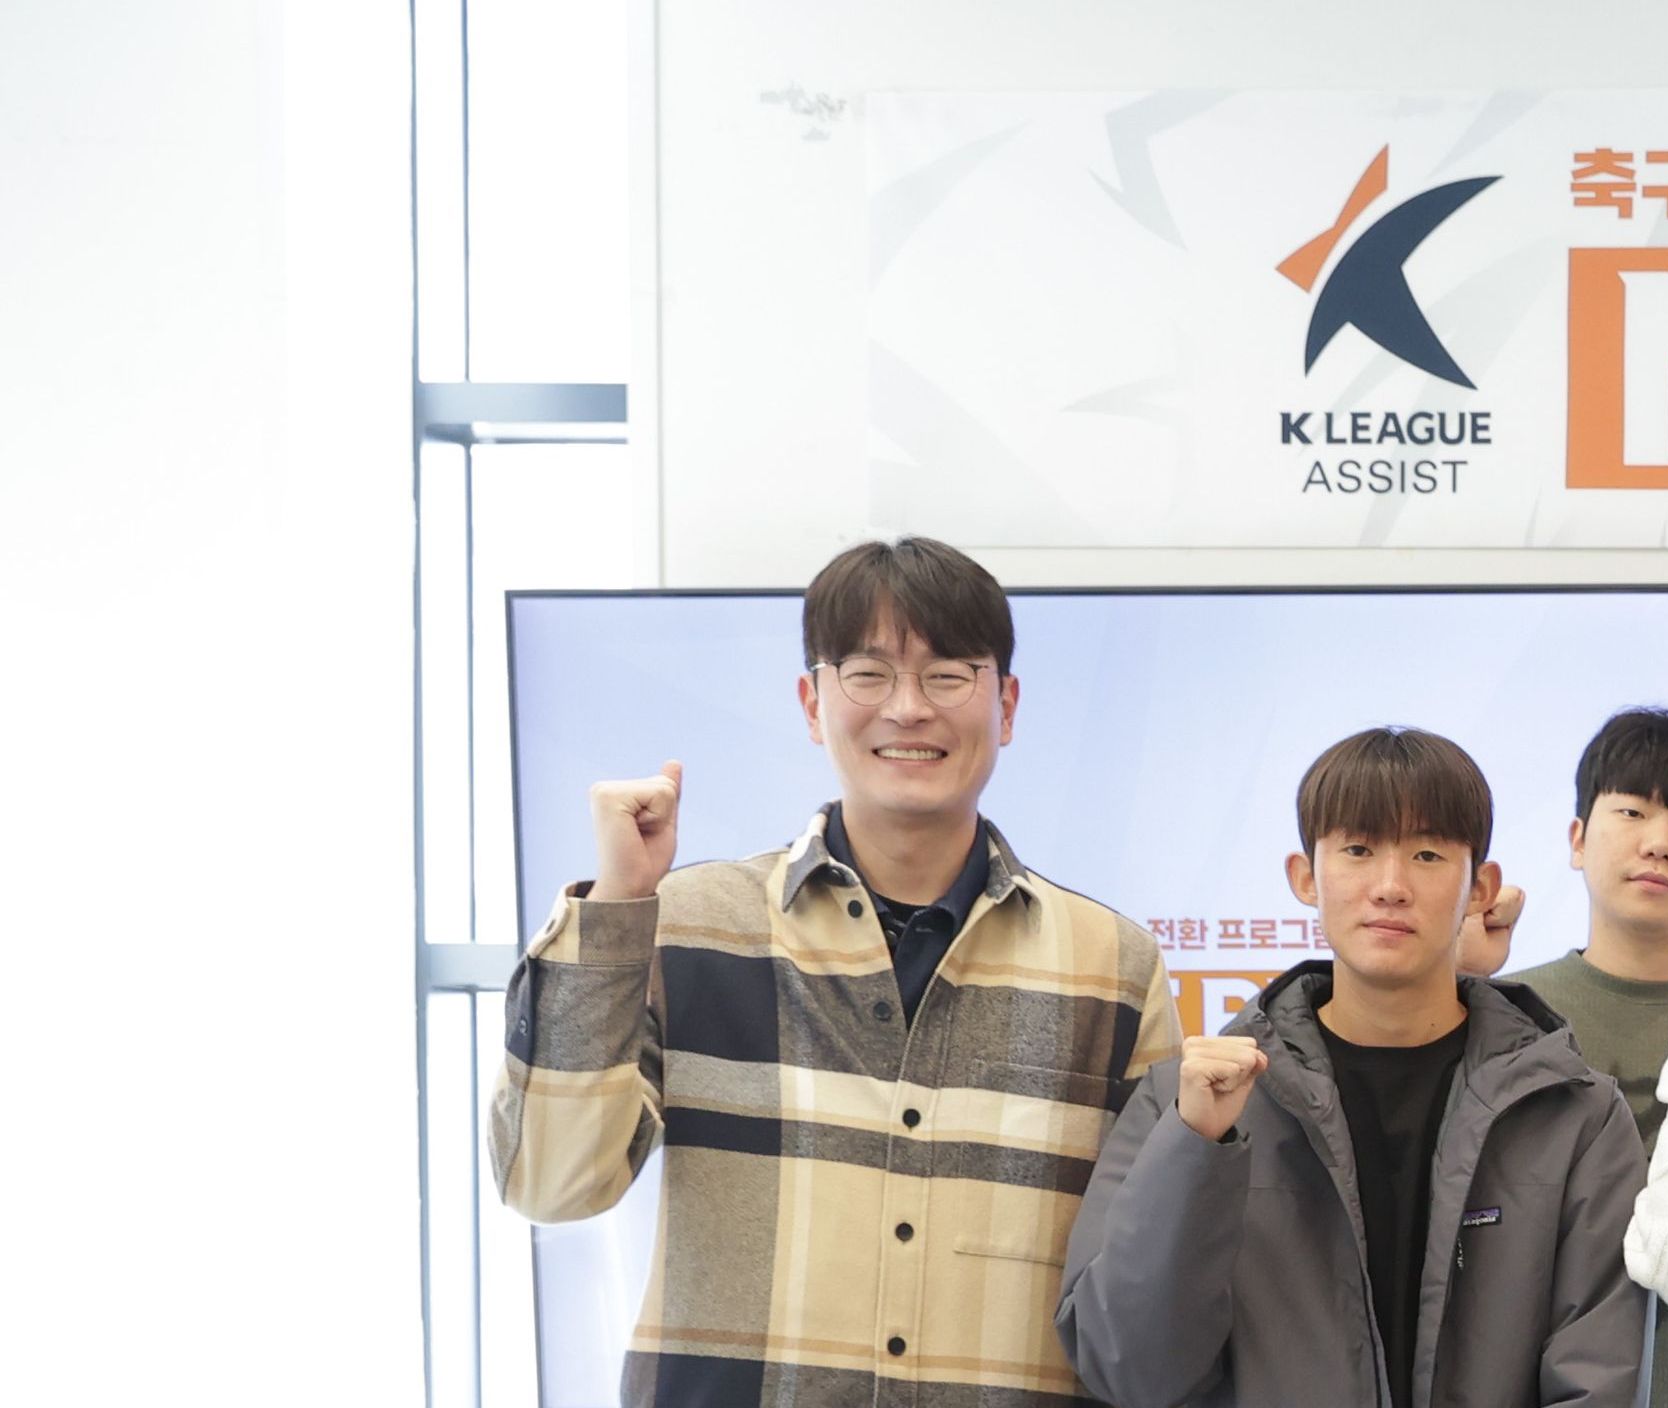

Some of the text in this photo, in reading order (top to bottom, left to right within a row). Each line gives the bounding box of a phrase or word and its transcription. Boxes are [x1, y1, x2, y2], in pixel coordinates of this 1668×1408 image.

[1280, 411, 1492, 445] K LEAGUE
[1303, 460, 1467, 494] ASSIST
[1148, 917, 1208, 950] 전환
